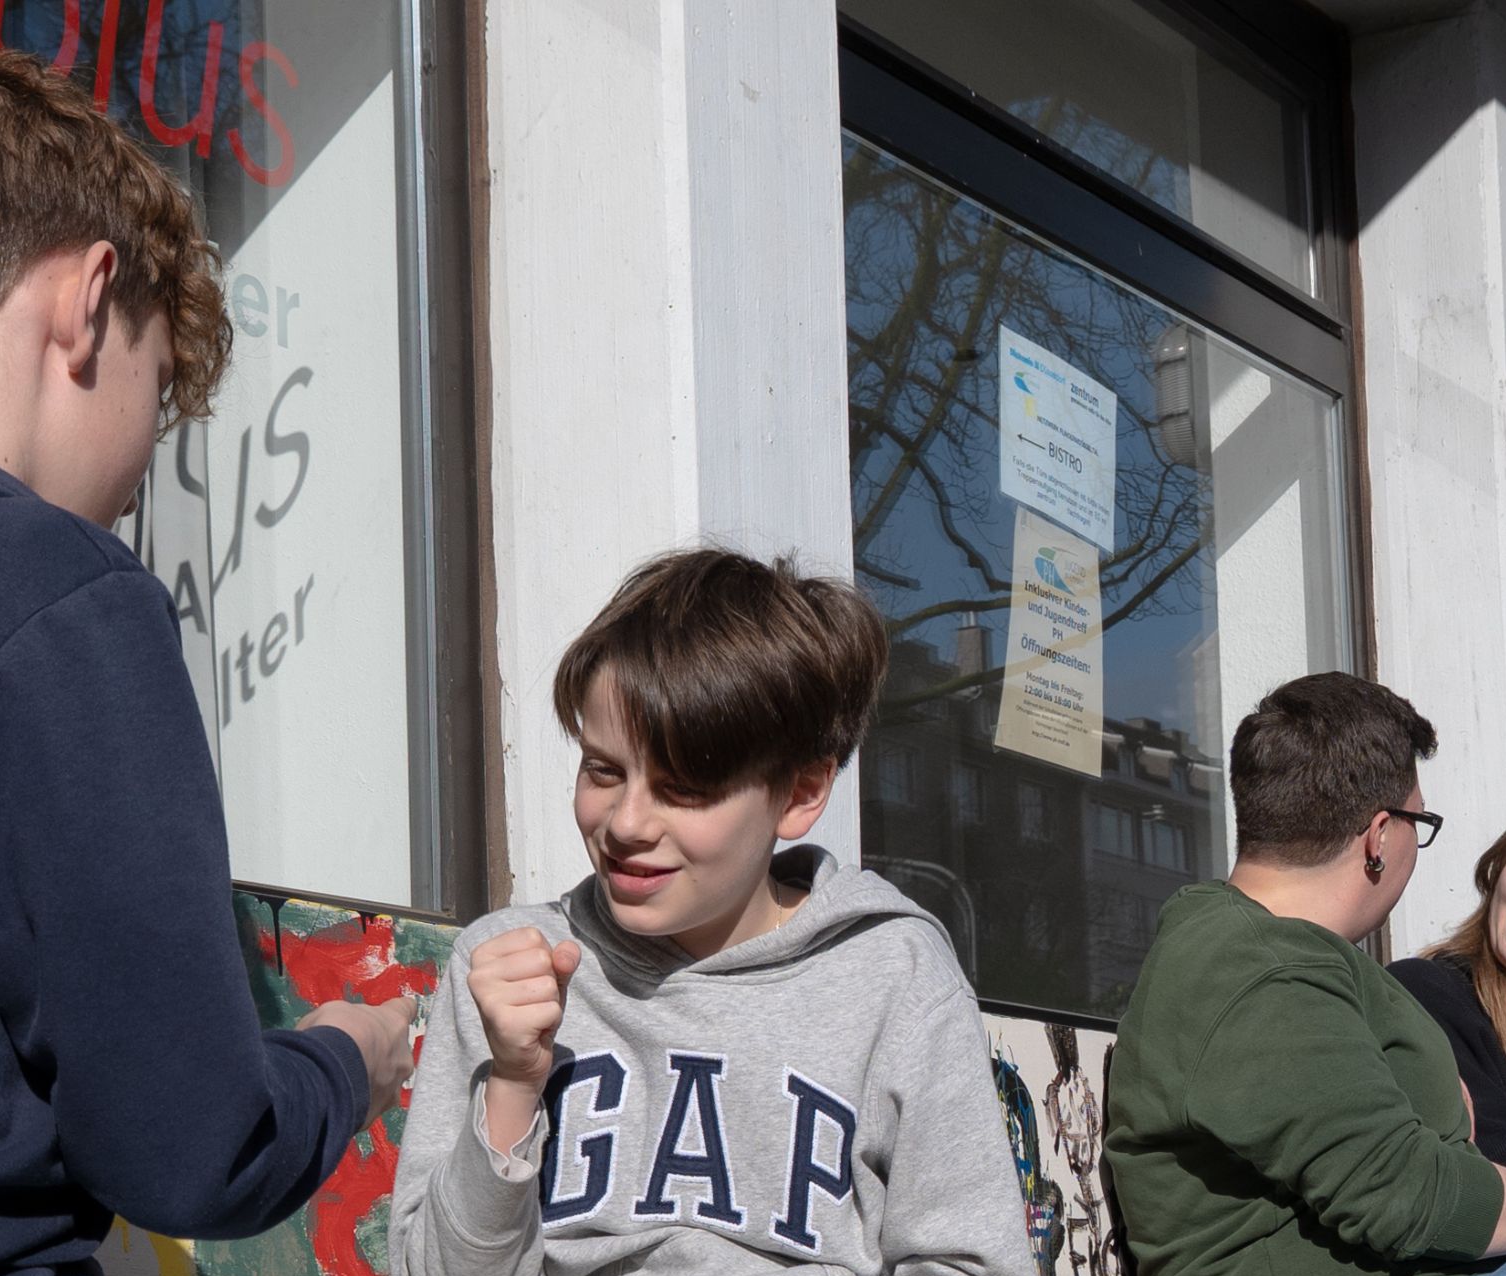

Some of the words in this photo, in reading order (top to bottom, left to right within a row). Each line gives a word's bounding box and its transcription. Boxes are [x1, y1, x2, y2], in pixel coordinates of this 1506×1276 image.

[1048, 441, 1082, 474] BISTRO
[1024, 579, 1062, 605] Inklusiver
[1064, 597, 1091, 617] Kinder-
[1027, 600, 1043, 615] und
[1044, 606, 1087, 634] Jugendtreff
[1052, 627, 1063, 641] PH
[1020, 633, 1091, 674] Öffnungszeiten:
[1025, 671, 1049, 689] Montag
[1050, 679, 1060, 691] bis
[1072, 700, 1084, 713] Uhr
[541, 1048, 858, 1256] GAP
